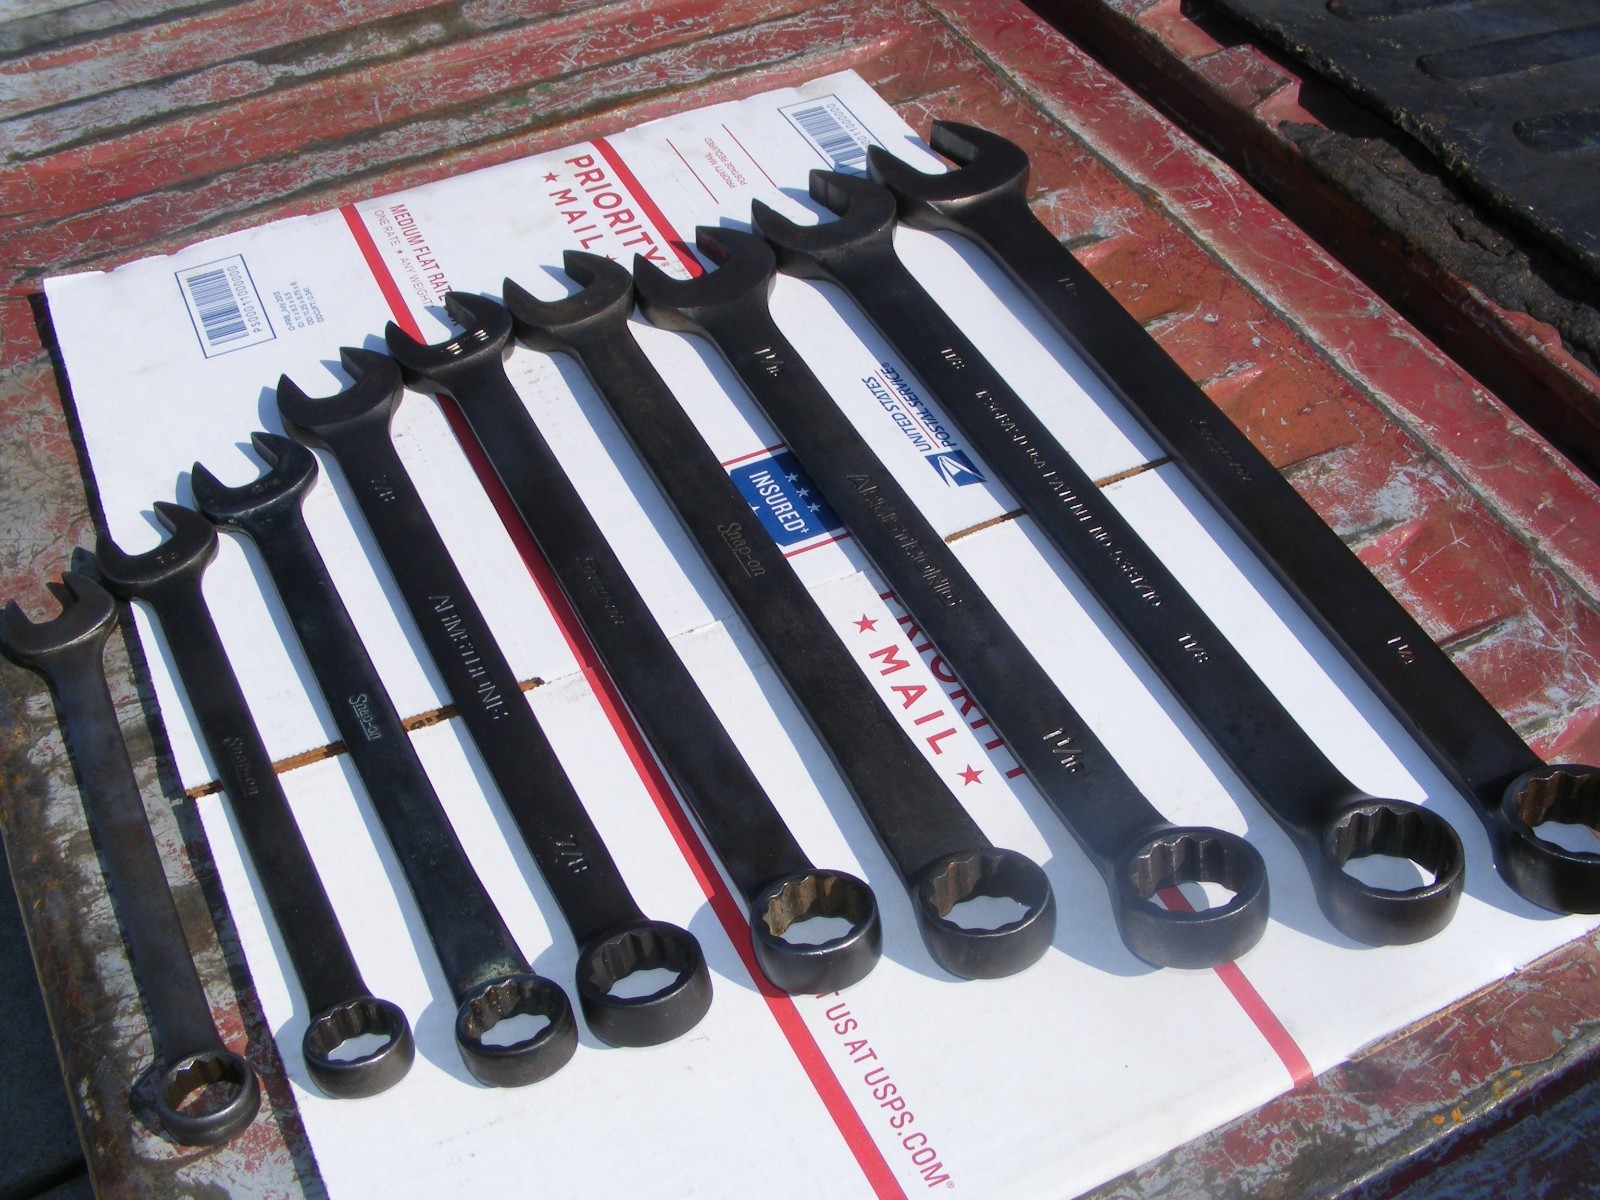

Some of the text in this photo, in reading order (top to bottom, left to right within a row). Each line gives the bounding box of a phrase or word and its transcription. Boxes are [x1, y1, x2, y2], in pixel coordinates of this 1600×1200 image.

[705, 138, 747, 185] POSTAGE REQUIRED
[715, 166, 736, 188] PRIORITY
[374, 209, 390, 226] ONE
[384, 226, 400, 246] RATE
[400, 257, 416, 273] ANY
[390, 204, 424, 245] MEDIUM
[413, 246, 440, 270] FLAT
[549, 189, 604, 250] MAIL
[861, 376, 932, 452] UNITED STATES
[916, 407, 957, 448] POSTAL
[716, 517, 767, 580] Snap-on
[868, 644, 958, 756] MAIL
[825, 1002, 858, 1035] US
[843, 1039, 878, 1063] AT
